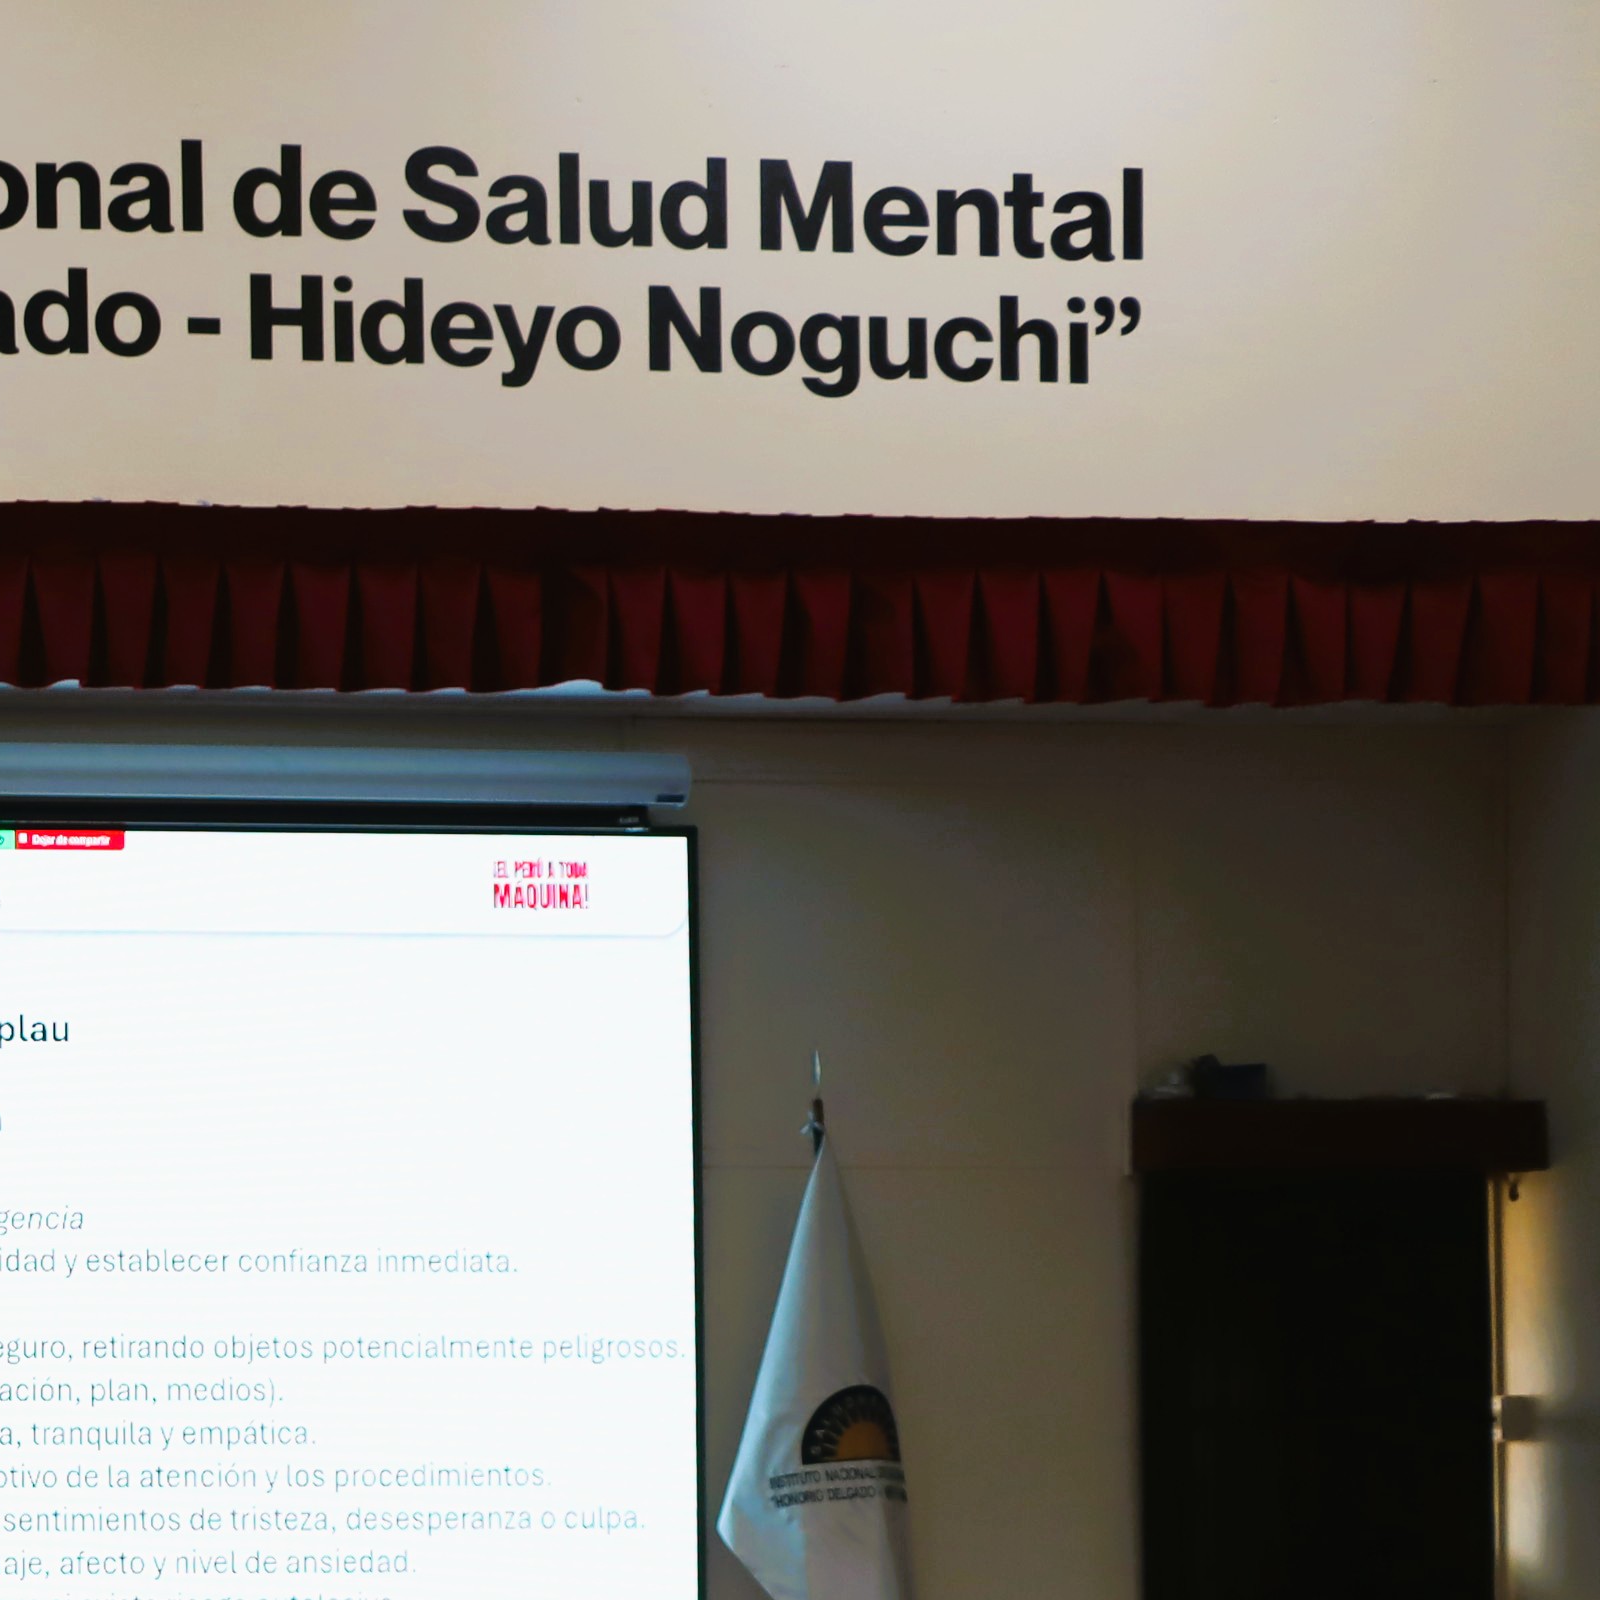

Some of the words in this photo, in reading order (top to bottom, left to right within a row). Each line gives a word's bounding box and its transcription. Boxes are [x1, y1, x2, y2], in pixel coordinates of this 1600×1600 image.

[231, 144, 379, 242] de
[401, 147, 729, 252] Salud
[758, 157, 1145, 264] Mental
[186, 316, 222, 336] -
[248, 272, 622, 389] Hideyo
[647, 284, 1142, 399] Noguchi”
[493, 880, 589, 910] MÁQUINA!
[63, 1253, 78, 1280] y
[84, 1247, 230, 1273] establecer
[237, 1247, 368, 1274] confianza
[377, 1247, 519, 1274] inmediata.
[82, 1332, 205, 1360] retirando
[213, 1333, 315, 1365] objetos
[322, 1333, 534, 1365] potencialmente
[542, 1334, 686, 1365] peligrosos.
[90, 1377, 158, 1408] plan,
[166, 1376, 284, 1409] medios).
[30, 1419, 153, 1452] tranquila
[159, 1425, 175, 1452] y
[181, 1419, 316, 1452] empática.
[2, 1505, 182, 1533] sentimientos
[188, 1506, 223, 1532] de
[229, 1504, 337, 1535] tristeza,
[346, 1506, 533, 1537] desesperanza
[540, 1510, 557, 1530] o
[563, 1505, 646, 1535] culpa.
